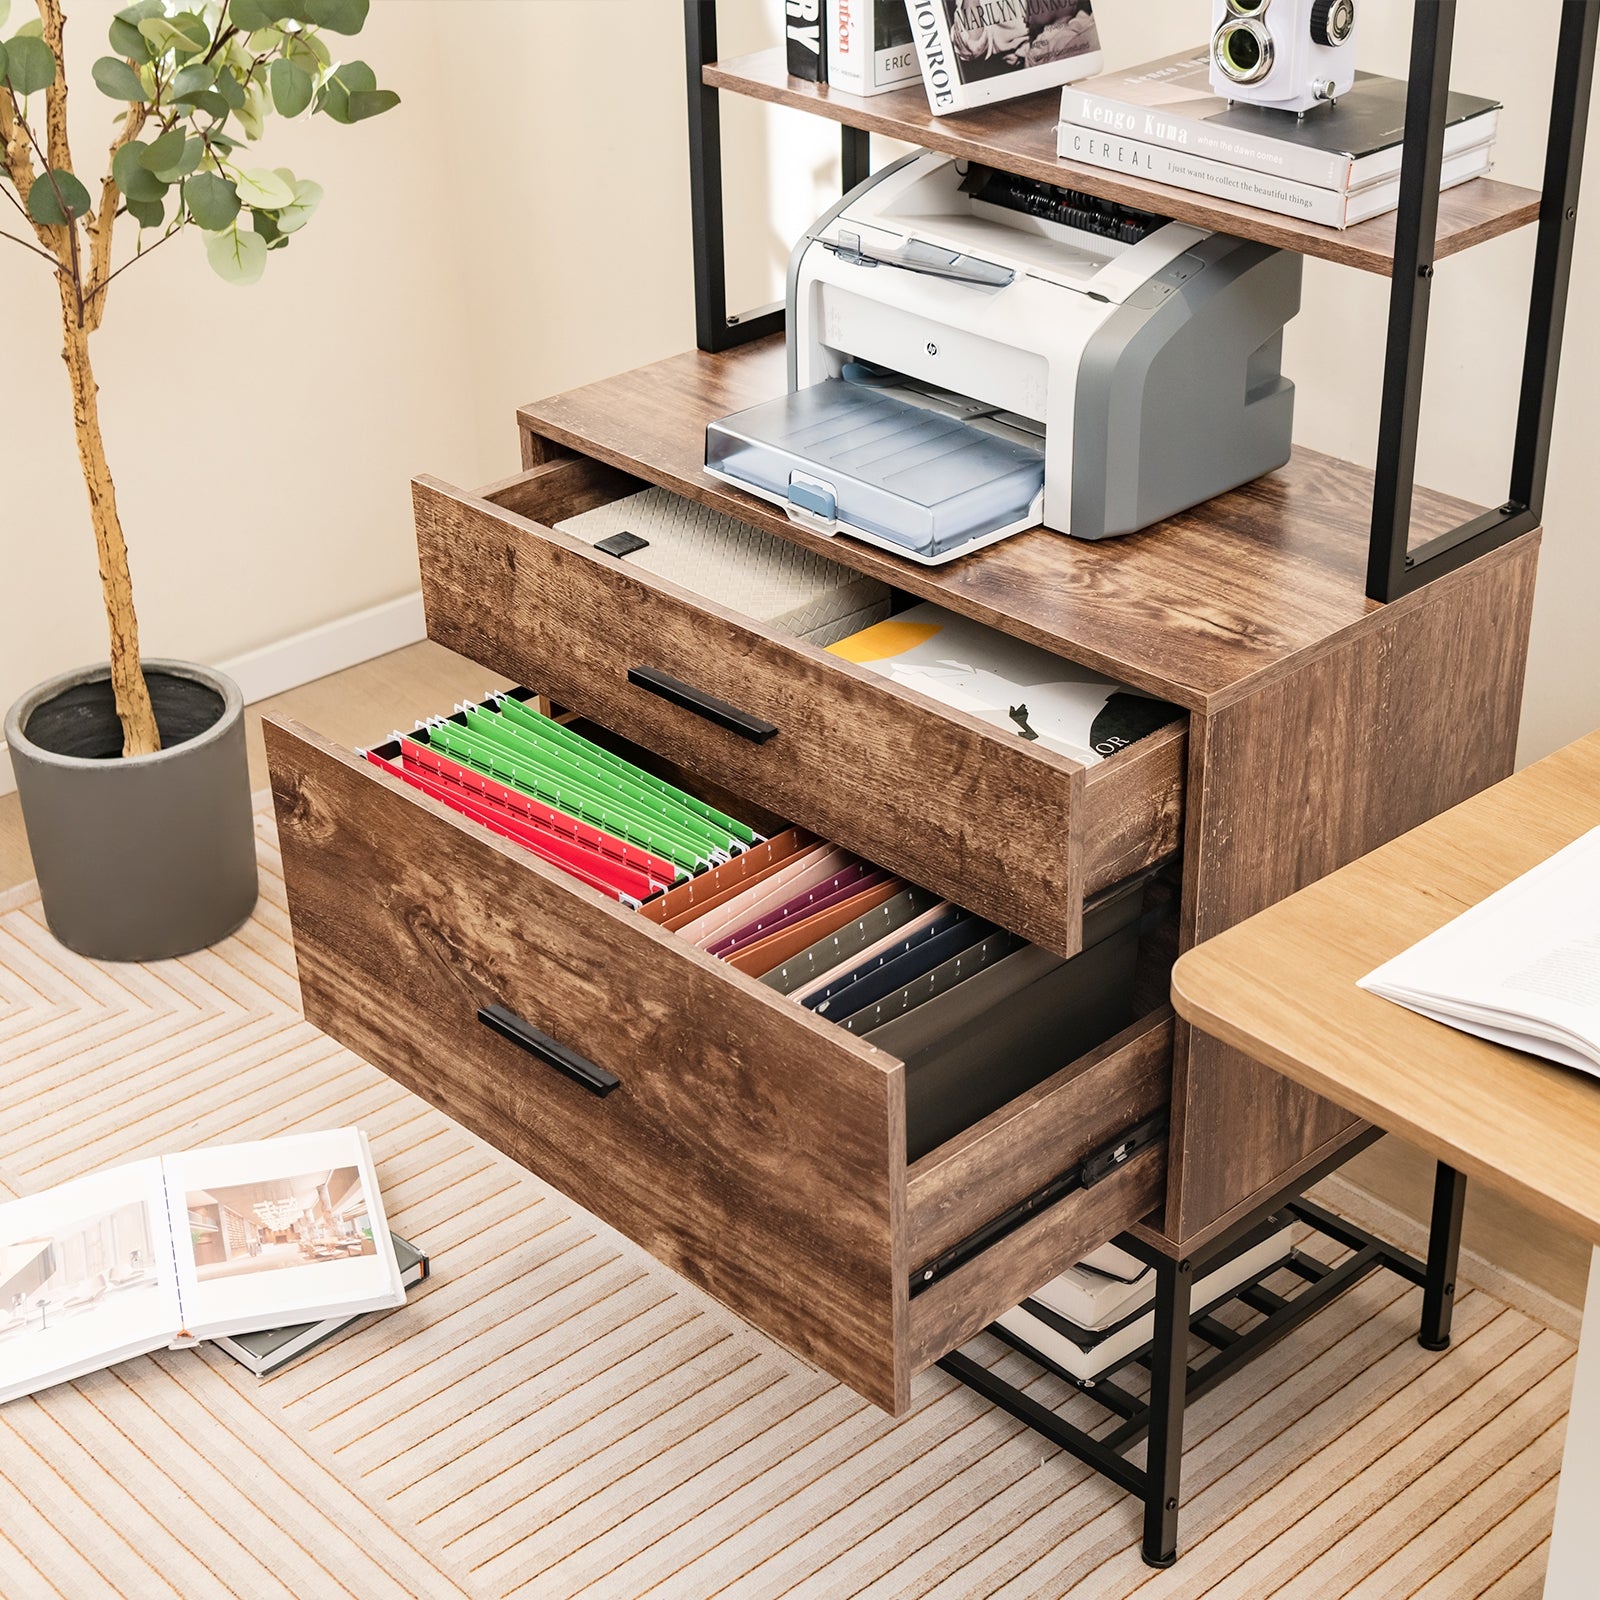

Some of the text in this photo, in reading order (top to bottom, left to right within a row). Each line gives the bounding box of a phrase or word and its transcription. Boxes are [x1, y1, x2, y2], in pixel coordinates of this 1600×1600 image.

[956, 0, 1018, 33] MARILYN
[885, 53, 911, 71] ERIC
[914, 0, 954, 107] ONROE
[1081, 98, 1284, 165] Kengo Kuma when the dawn comes
[1073, 135, 1153, 170] CEREAL
[1171, 163, 1186, 176] just
[1187, 167, 1205, 180] want
[1206, 173, 1215, 182] to
[1215, 175, 1239, 189] collect
[1240, 181, 1253, 192] the
[1253, 183, 1288, 201] beautiful
[1288, 193, 1313, 208] things
